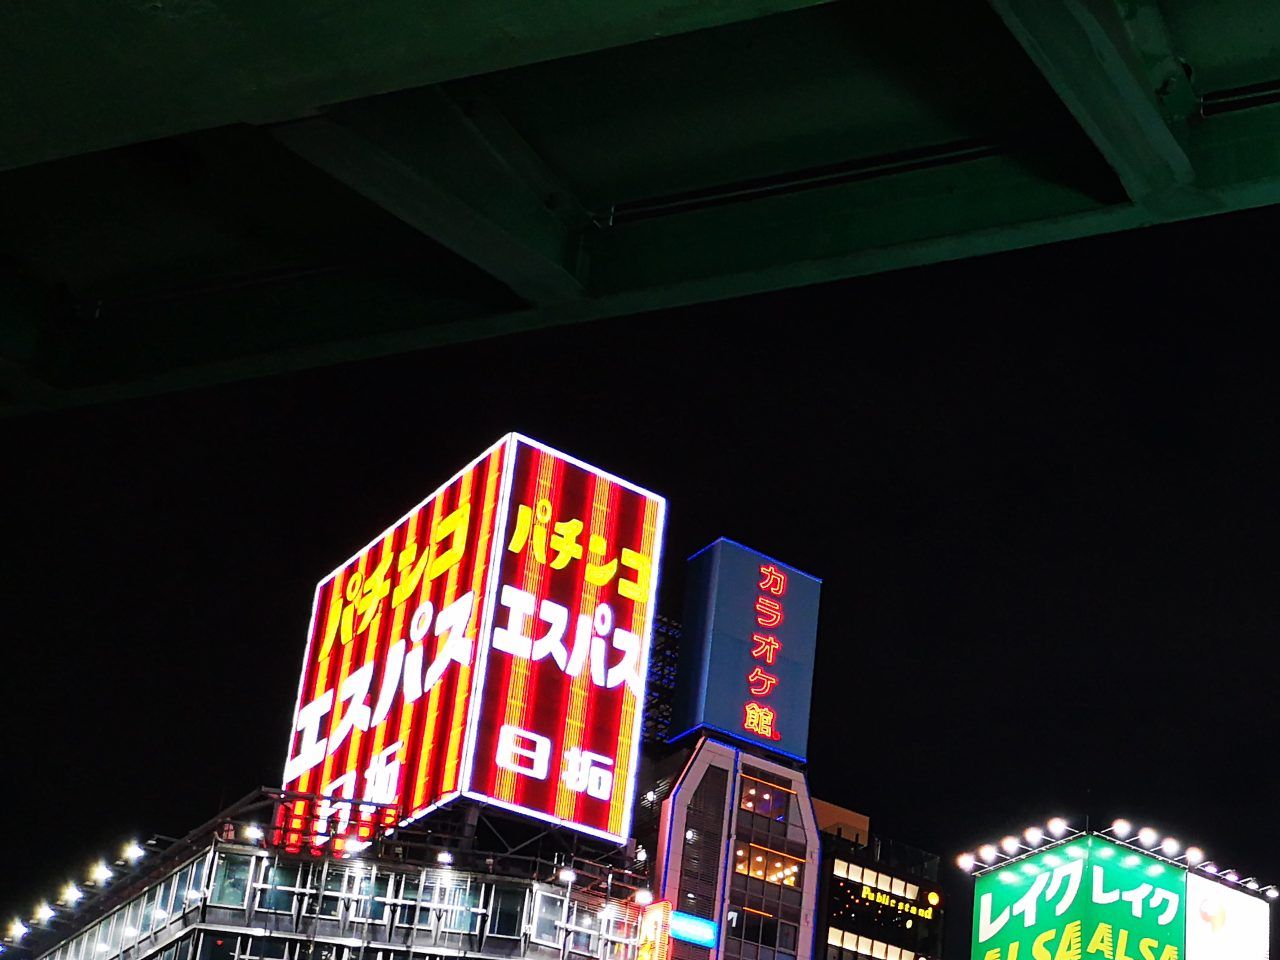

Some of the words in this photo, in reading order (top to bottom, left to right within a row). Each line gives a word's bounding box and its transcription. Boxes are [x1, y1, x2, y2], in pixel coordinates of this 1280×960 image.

[318, 503, 470, 662] パチンコ
[508, 498, 651, 603] パチンコ
[286, 591, 476, 782] エスパス
[492, 585, 646, 698] エスパス
[744, 563, 787, 739] カラオケ館
[496, 725, 613, 801] 日拓
[978, 858, 1084, 943] レイク
[1092, 865, 1179, 926] レイク
